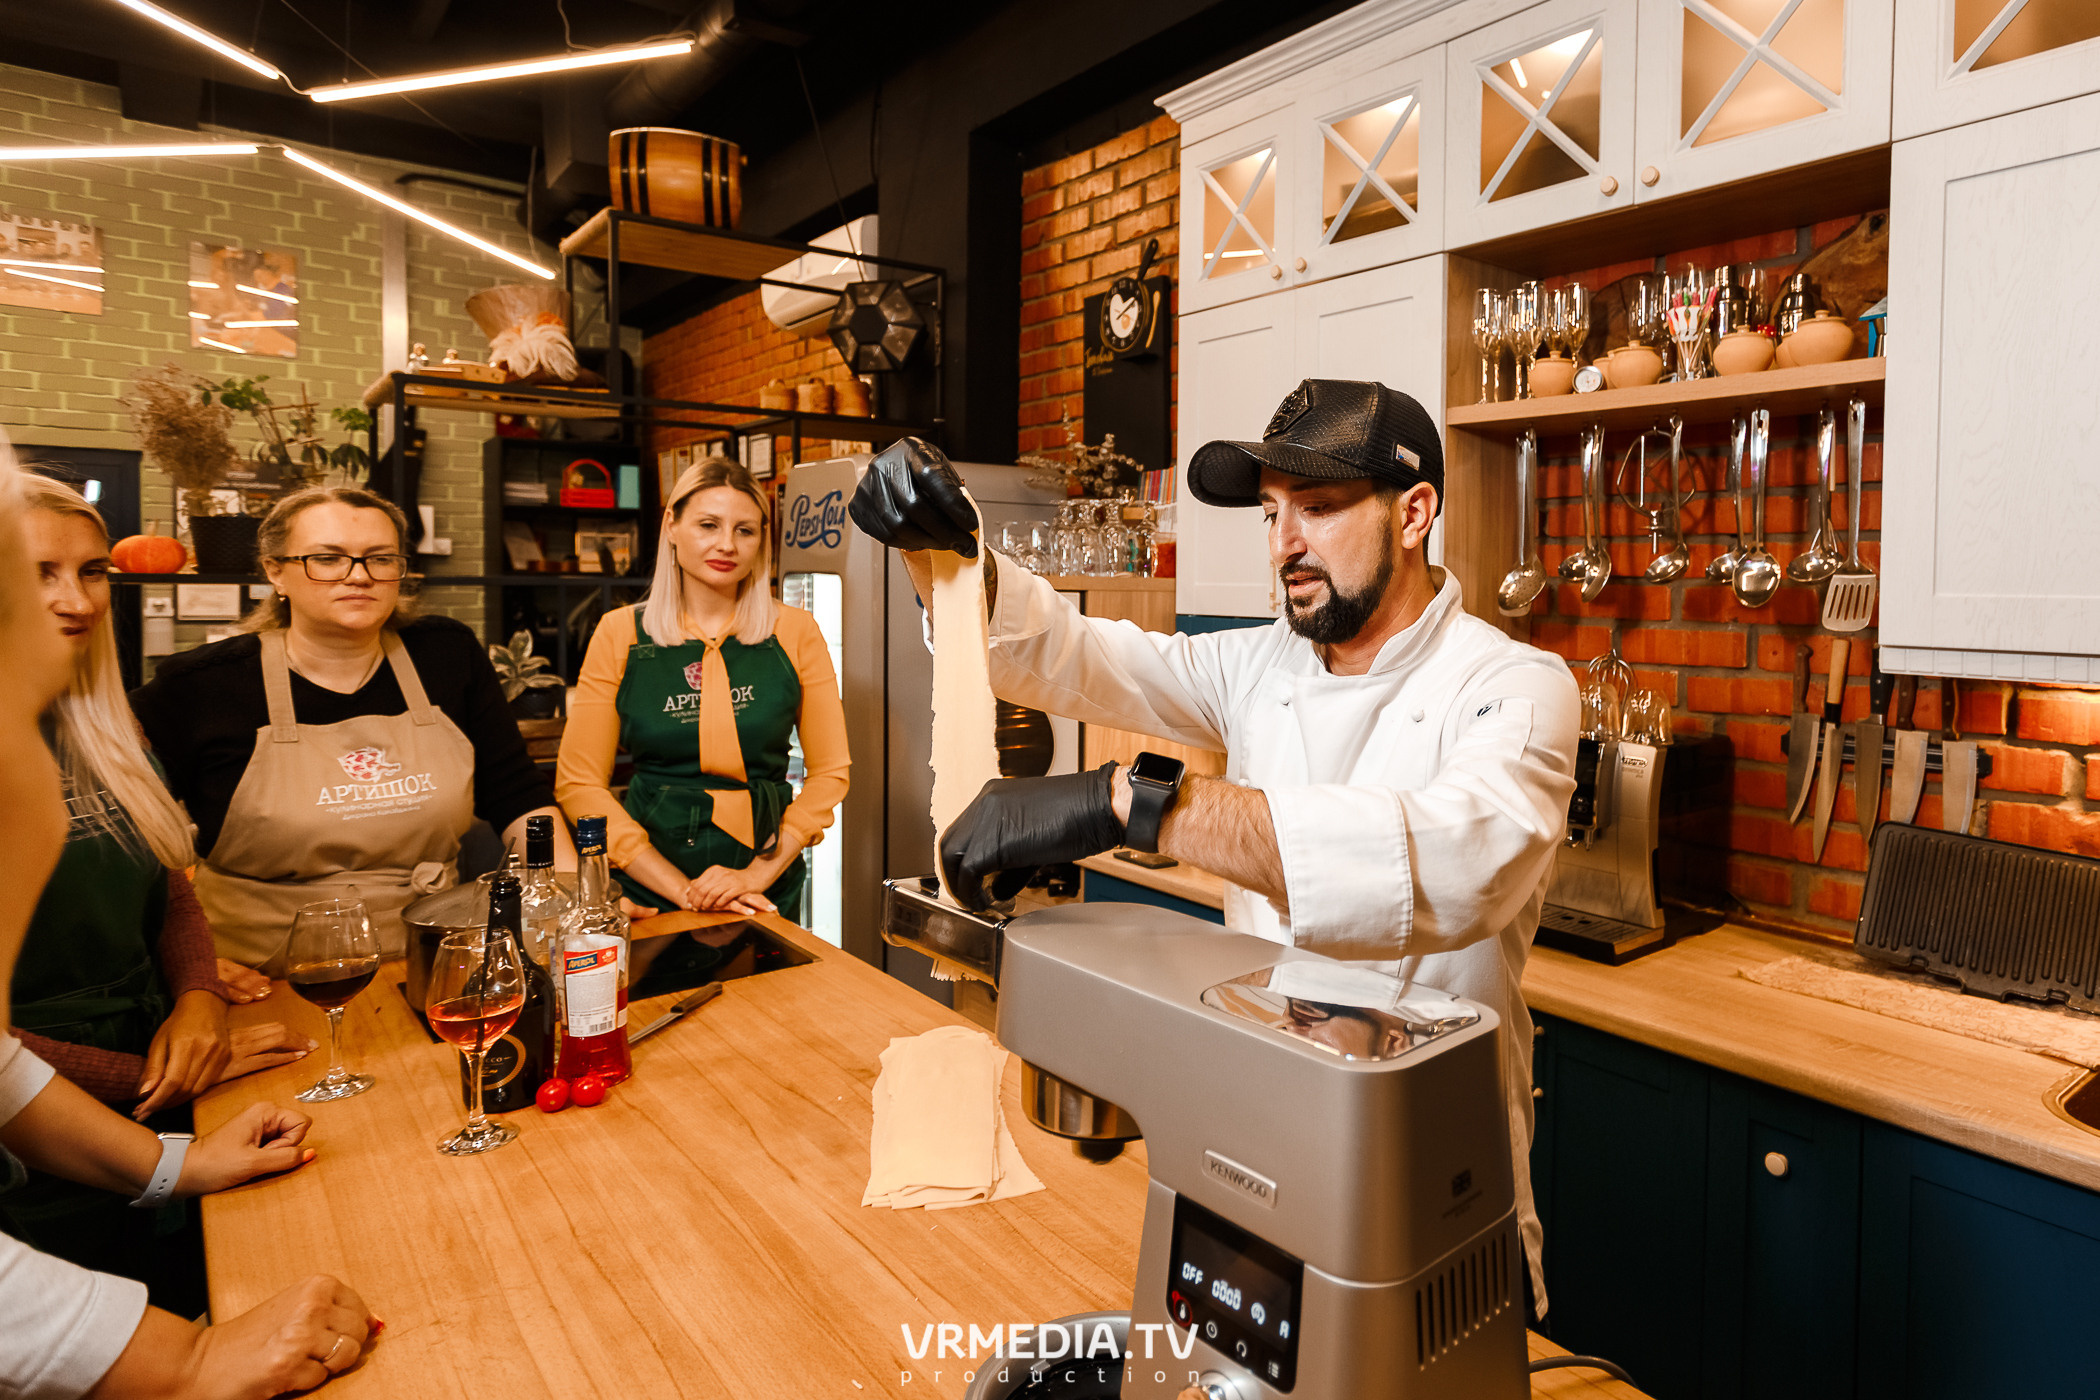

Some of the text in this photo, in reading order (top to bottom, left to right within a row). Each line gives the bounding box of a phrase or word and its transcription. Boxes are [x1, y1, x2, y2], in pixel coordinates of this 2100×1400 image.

[663, 685, 755, 712] АРТОК
[316, 773, 438, 805] АРТИШОК
[568, 957, 596, 969] APEROL
[1210, 1159, 1268, 1200] KENWOOD
[1182, 1262, 1203, 1285] OFF
